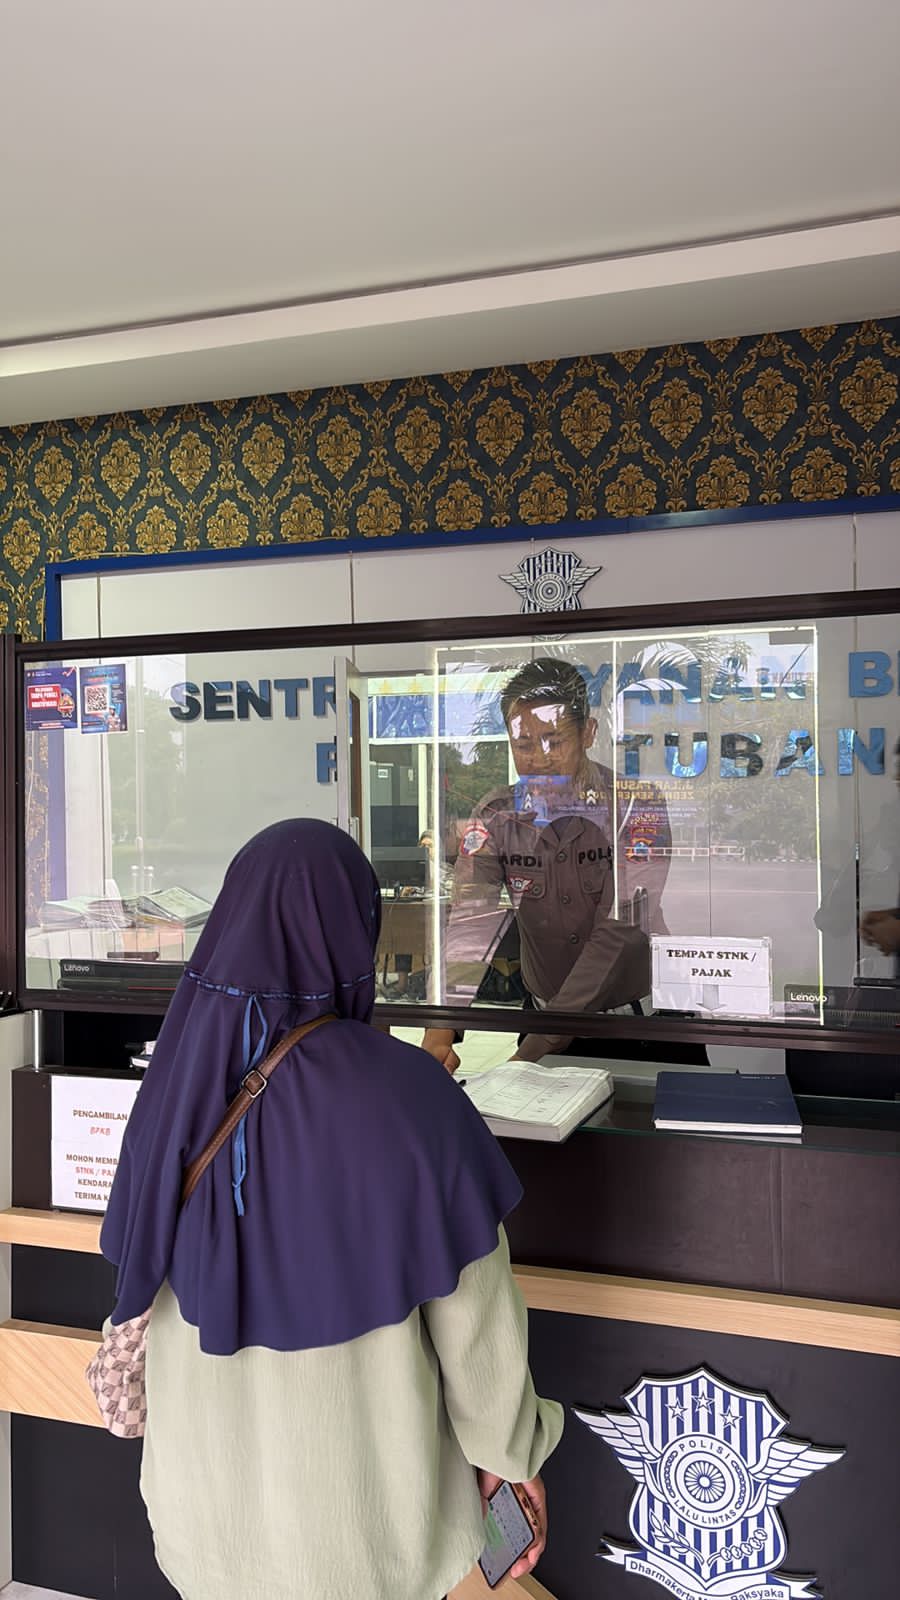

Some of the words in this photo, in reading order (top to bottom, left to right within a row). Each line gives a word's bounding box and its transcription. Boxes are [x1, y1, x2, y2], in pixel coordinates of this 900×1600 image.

[848, 651, 900, 698] B
[613, 727, 885, 778] TUBAN
[667, 949, 713, 959] TEMPAT
[717, 950, 749, 960] STNK
[751, 952, 757, 962] /
[691, 967, 732, 978] PAJAK
[790, 992, 827, 1002] Lenovo
[73, 1109, 128, 1121] PENGAMBILAN
[66, 1154, 94, 1163] MOHON
[75, 1166, 94, 1175] STNK
[74, 1191, 102, 1200] TERIMA
[679, 1440, 730, 1459] POLISI
[674, 1500, 699, 1520] LALU
[701, 1509, 736, 1524] LINTAS
